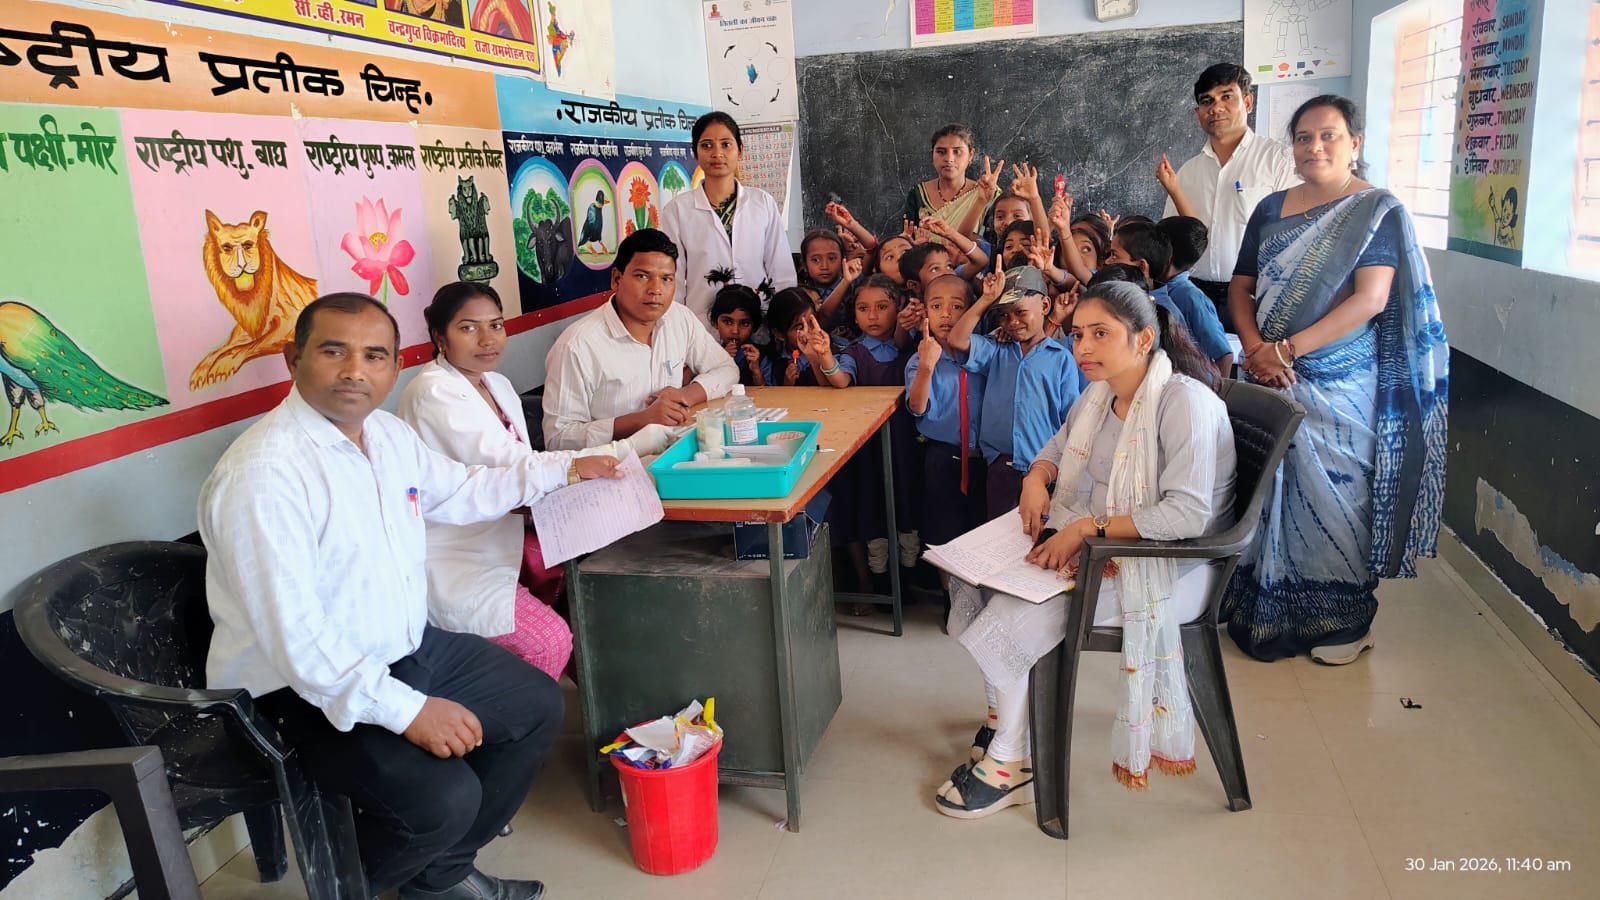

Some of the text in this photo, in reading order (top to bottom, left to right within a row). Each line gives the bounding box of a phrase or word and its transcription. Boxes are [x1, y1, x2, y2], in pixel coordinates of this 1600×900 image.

[198, 51, 345, 97] प्रतीक
[641, 106, 676, 131] प्रतीक
[134, 129, 208, 176] राष्ट्रीय
[303, 134, 359, 176] राष्ट्रीय
[420, 139, 456, 172] राष्ट्रीय
[455, 141, 484, 169] प्रतीक
